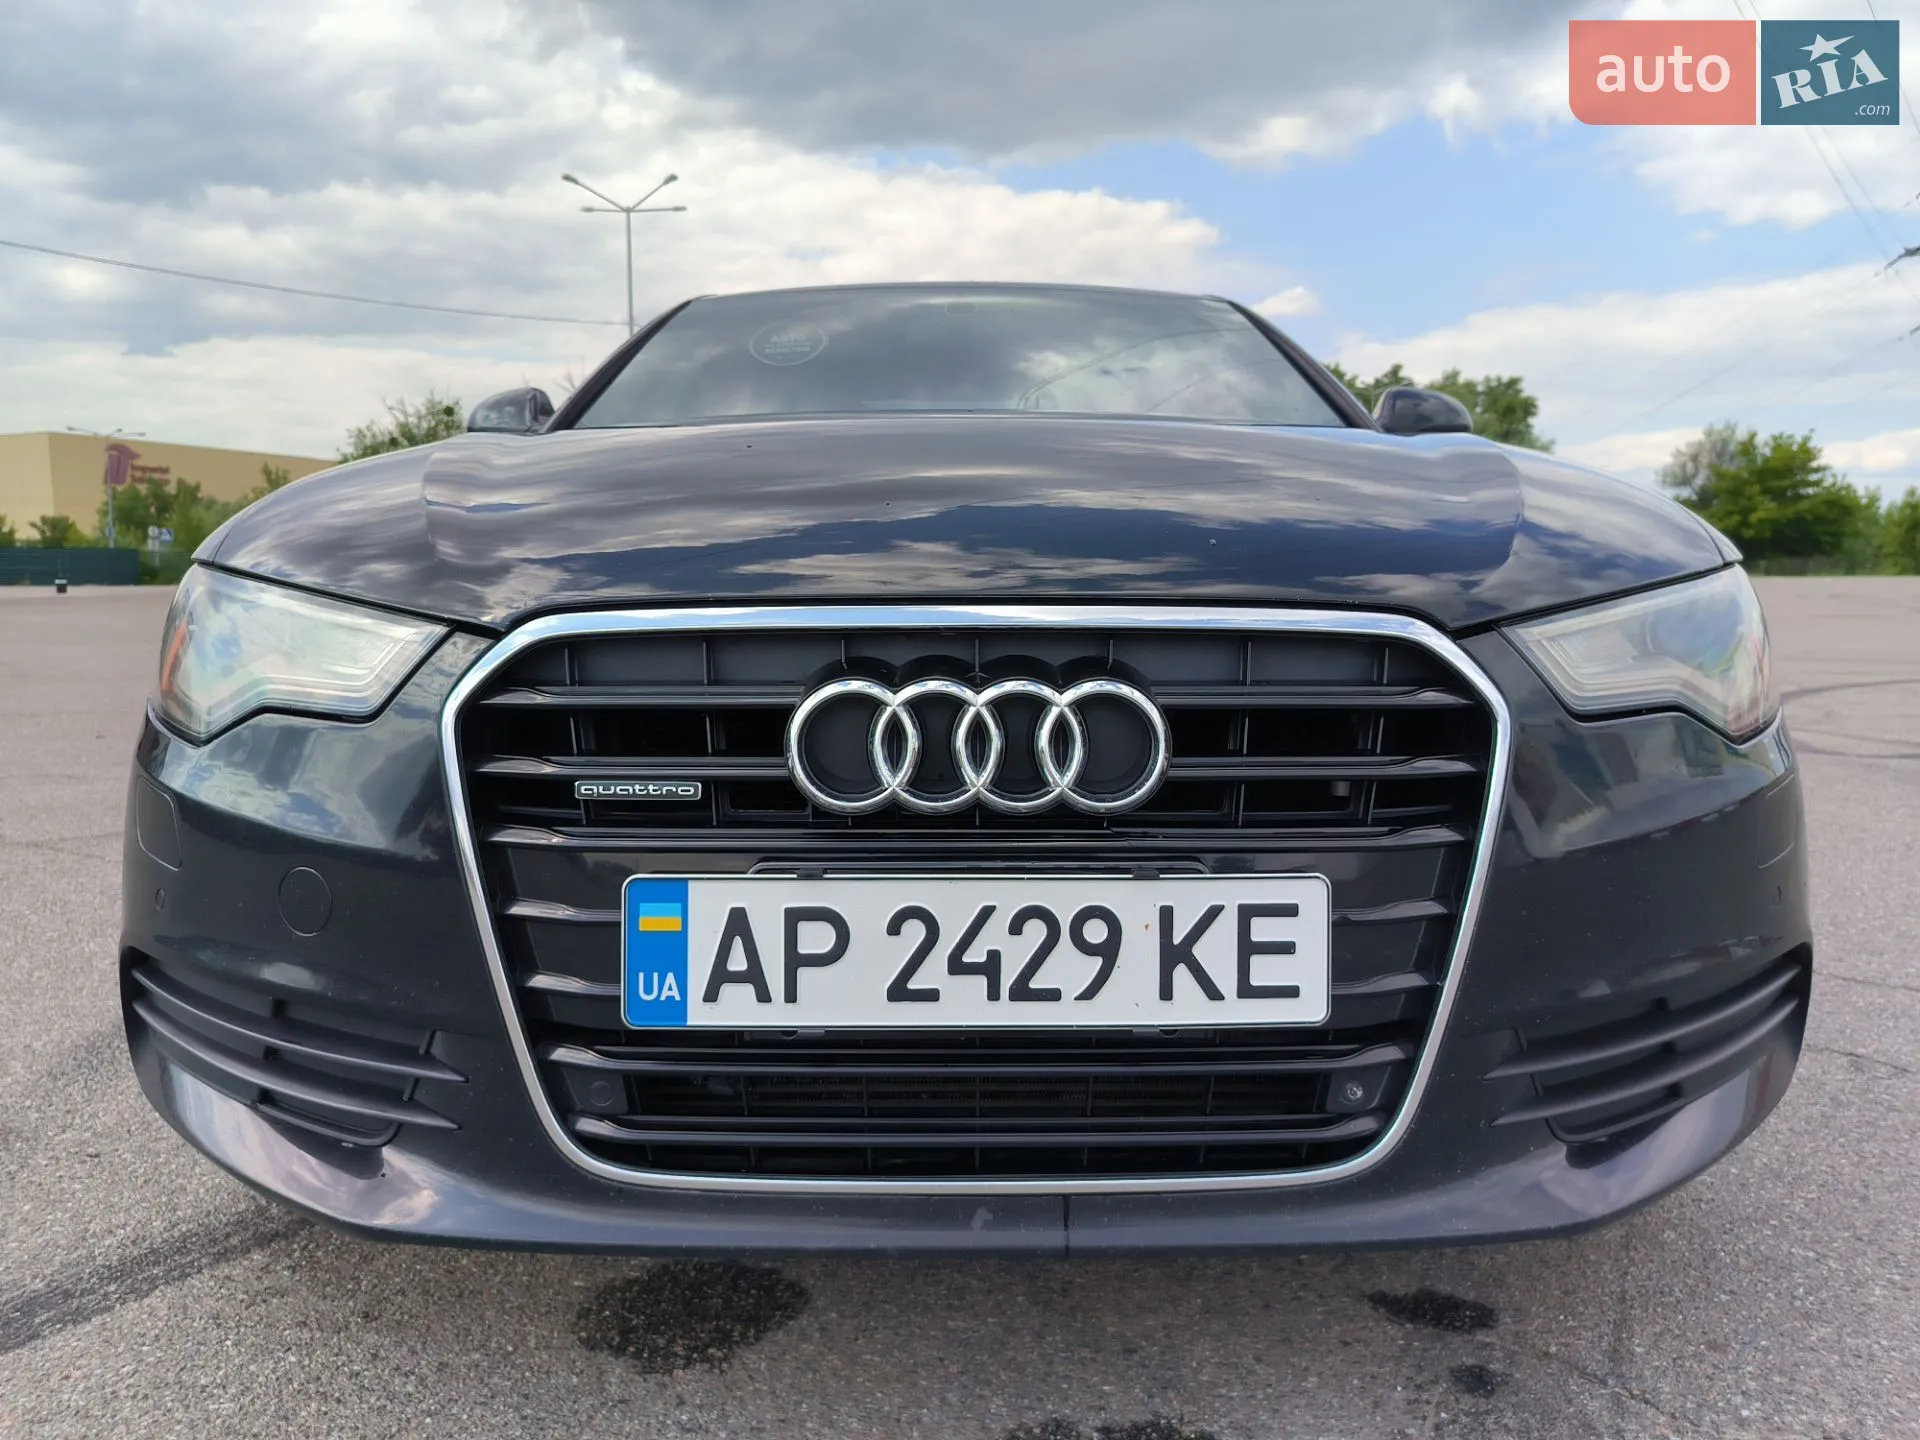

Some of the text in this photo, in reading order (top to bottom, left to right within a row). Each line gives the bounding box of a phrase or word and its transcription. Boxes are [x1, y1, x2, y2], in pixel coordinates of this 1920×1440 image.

[580, 784, 695, 797] quattro
[702, 903, 1300, 1003] AP 2429 KE
[638, 972, 682, 1002] UA
